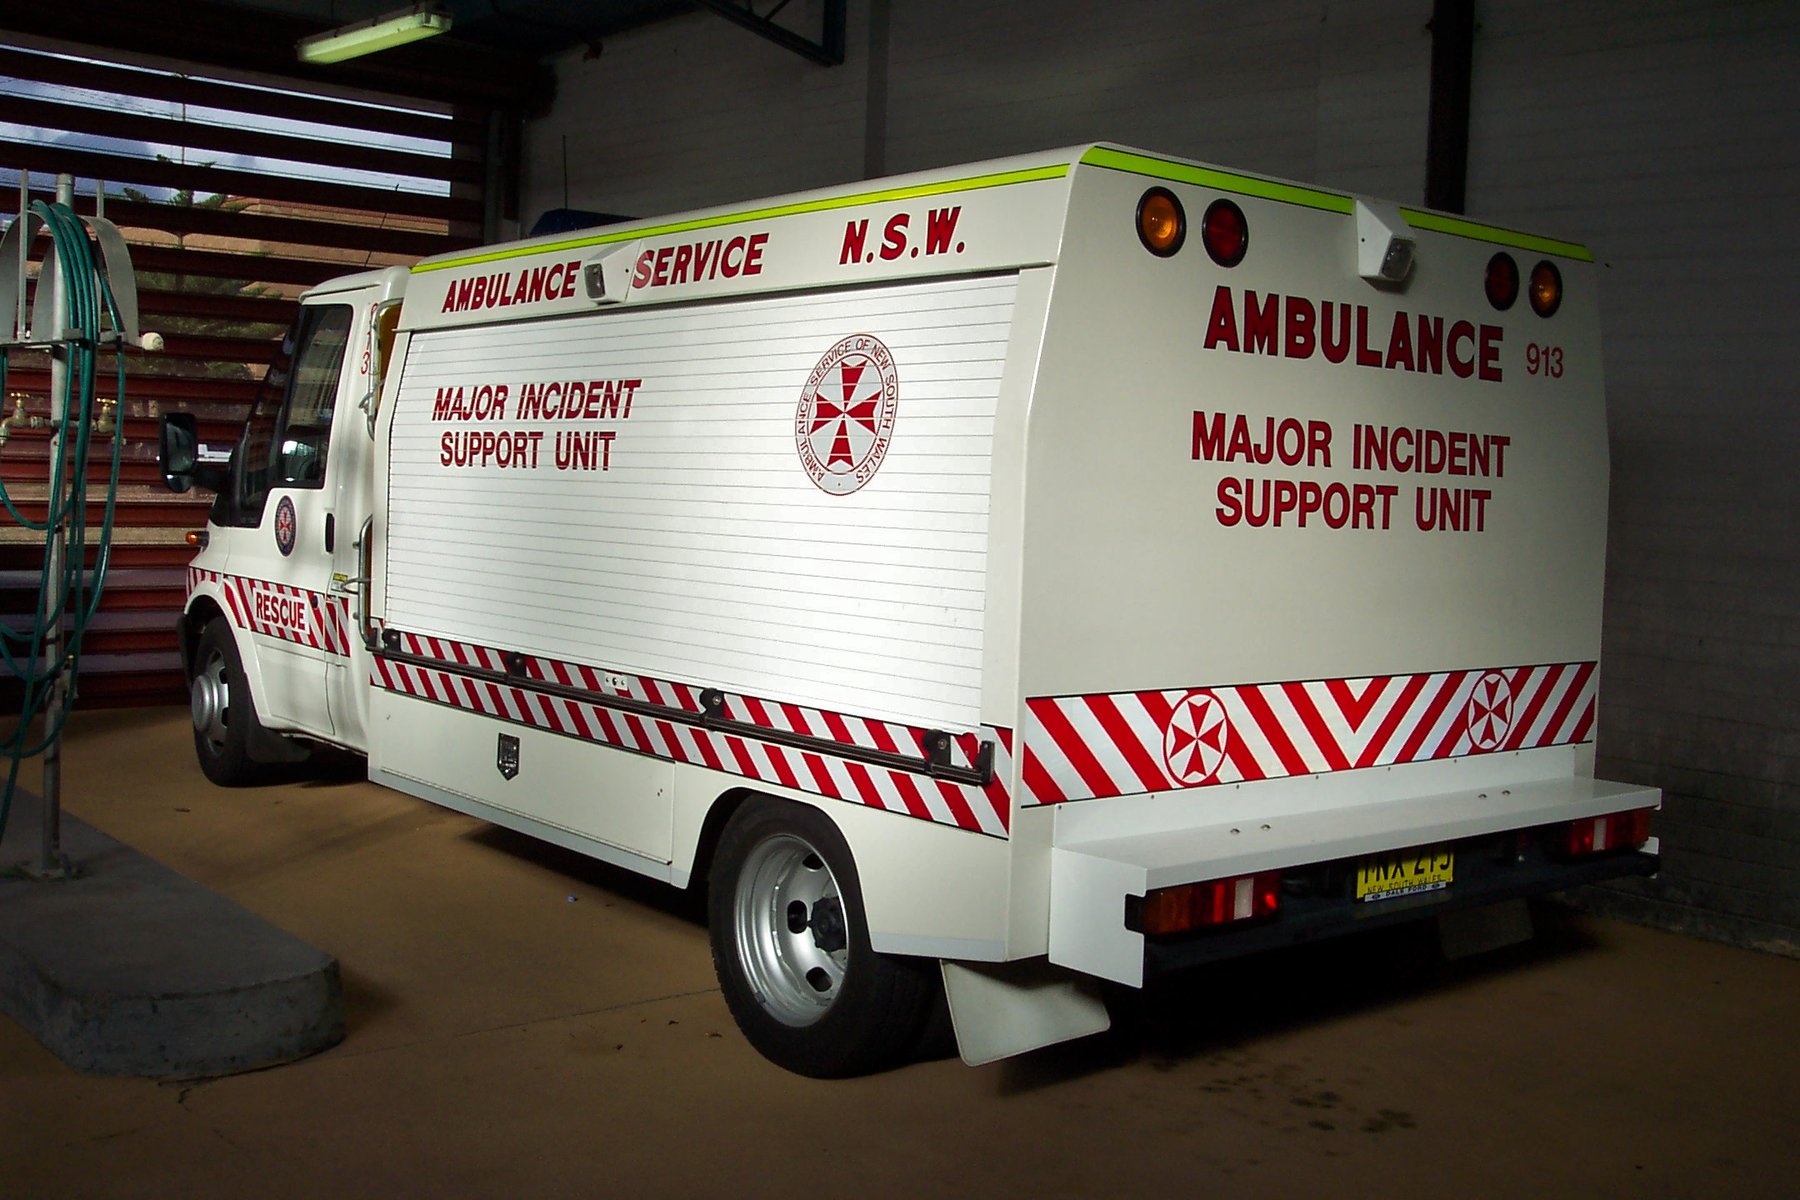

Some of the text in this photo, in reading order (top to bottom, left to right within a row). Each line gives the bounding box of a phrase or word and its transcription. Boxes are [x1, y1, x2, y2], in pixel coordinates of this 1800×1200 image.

[442, 206, 966, 313] AMBULANCE SERVICE N.S.W.
[1204, 286, 1504, 382] AMBULANCE
[1526, 342, 1564, 378] 913
[431, 379, 642, 422] MAJOR INCIDENT
[798, 338, 896, 484] AMBULANCE SERVICE OF NEW SOUTH WALES
[439, 431, 617, 471] SUPPORT UNIT
[1191, 410, 1511, 478] MAJOR INCIDENT
[1215, 476, 1492, 532] SUPPORT UNIT
[256, 591, 306, 631] RESCUE
